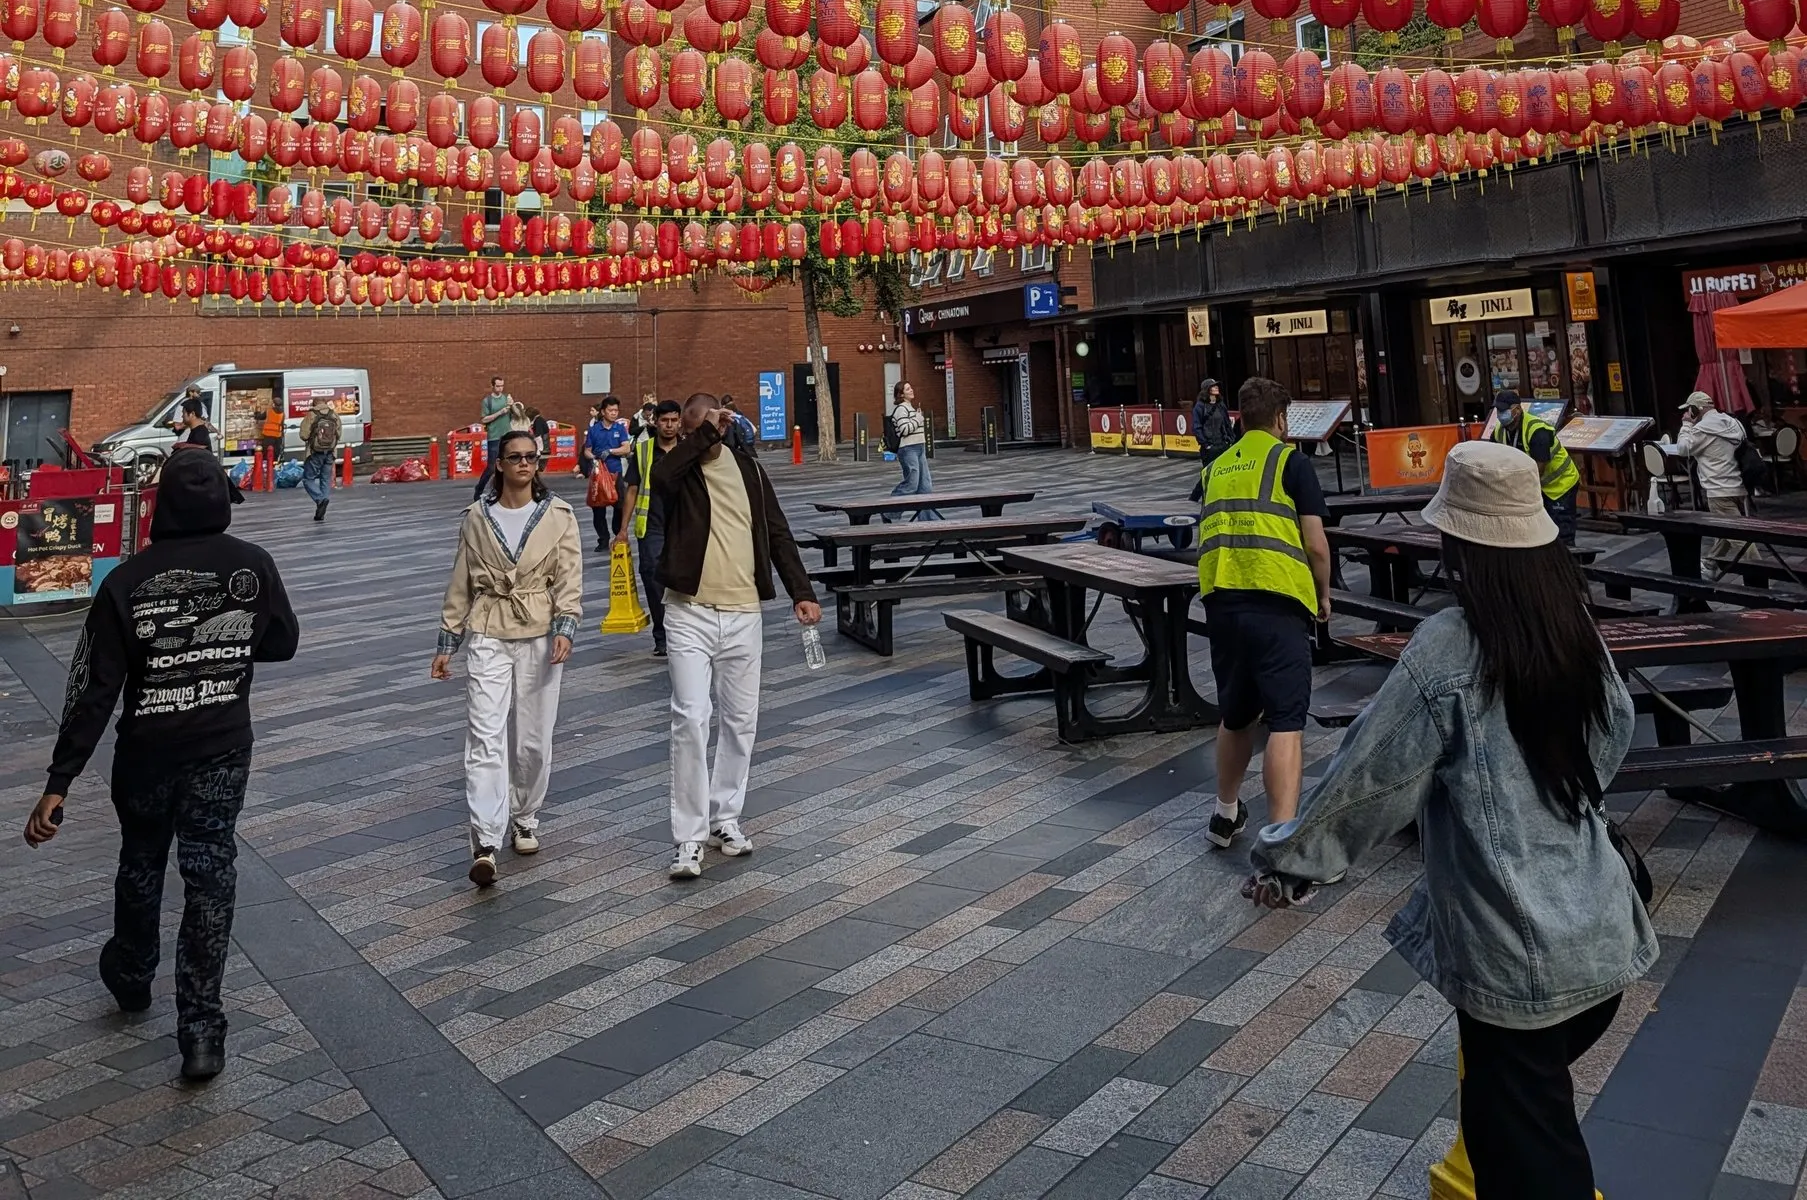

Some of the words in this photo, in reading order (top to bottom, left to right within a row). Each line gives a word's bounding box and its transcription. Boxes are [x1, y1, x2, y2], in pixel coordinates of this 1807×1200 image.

[1705, 273, 1756, 293] BUFFET
[938, 306, 969, 320] CHINATOWN
[1480, 297, 1513, 317] JINLI
[1578, 308, 1597, 316] BUFFET
[1290, 317, 1313, 333] JINLI
[1213, 460, 1256, 477] Gentwell
[132, 606, 179, 619] STREETS
[146, 646, 252, 669] HOODRICH
[135, 704, 175, 717] NEVER
[178, 693, 237, 712] SATISFIED
